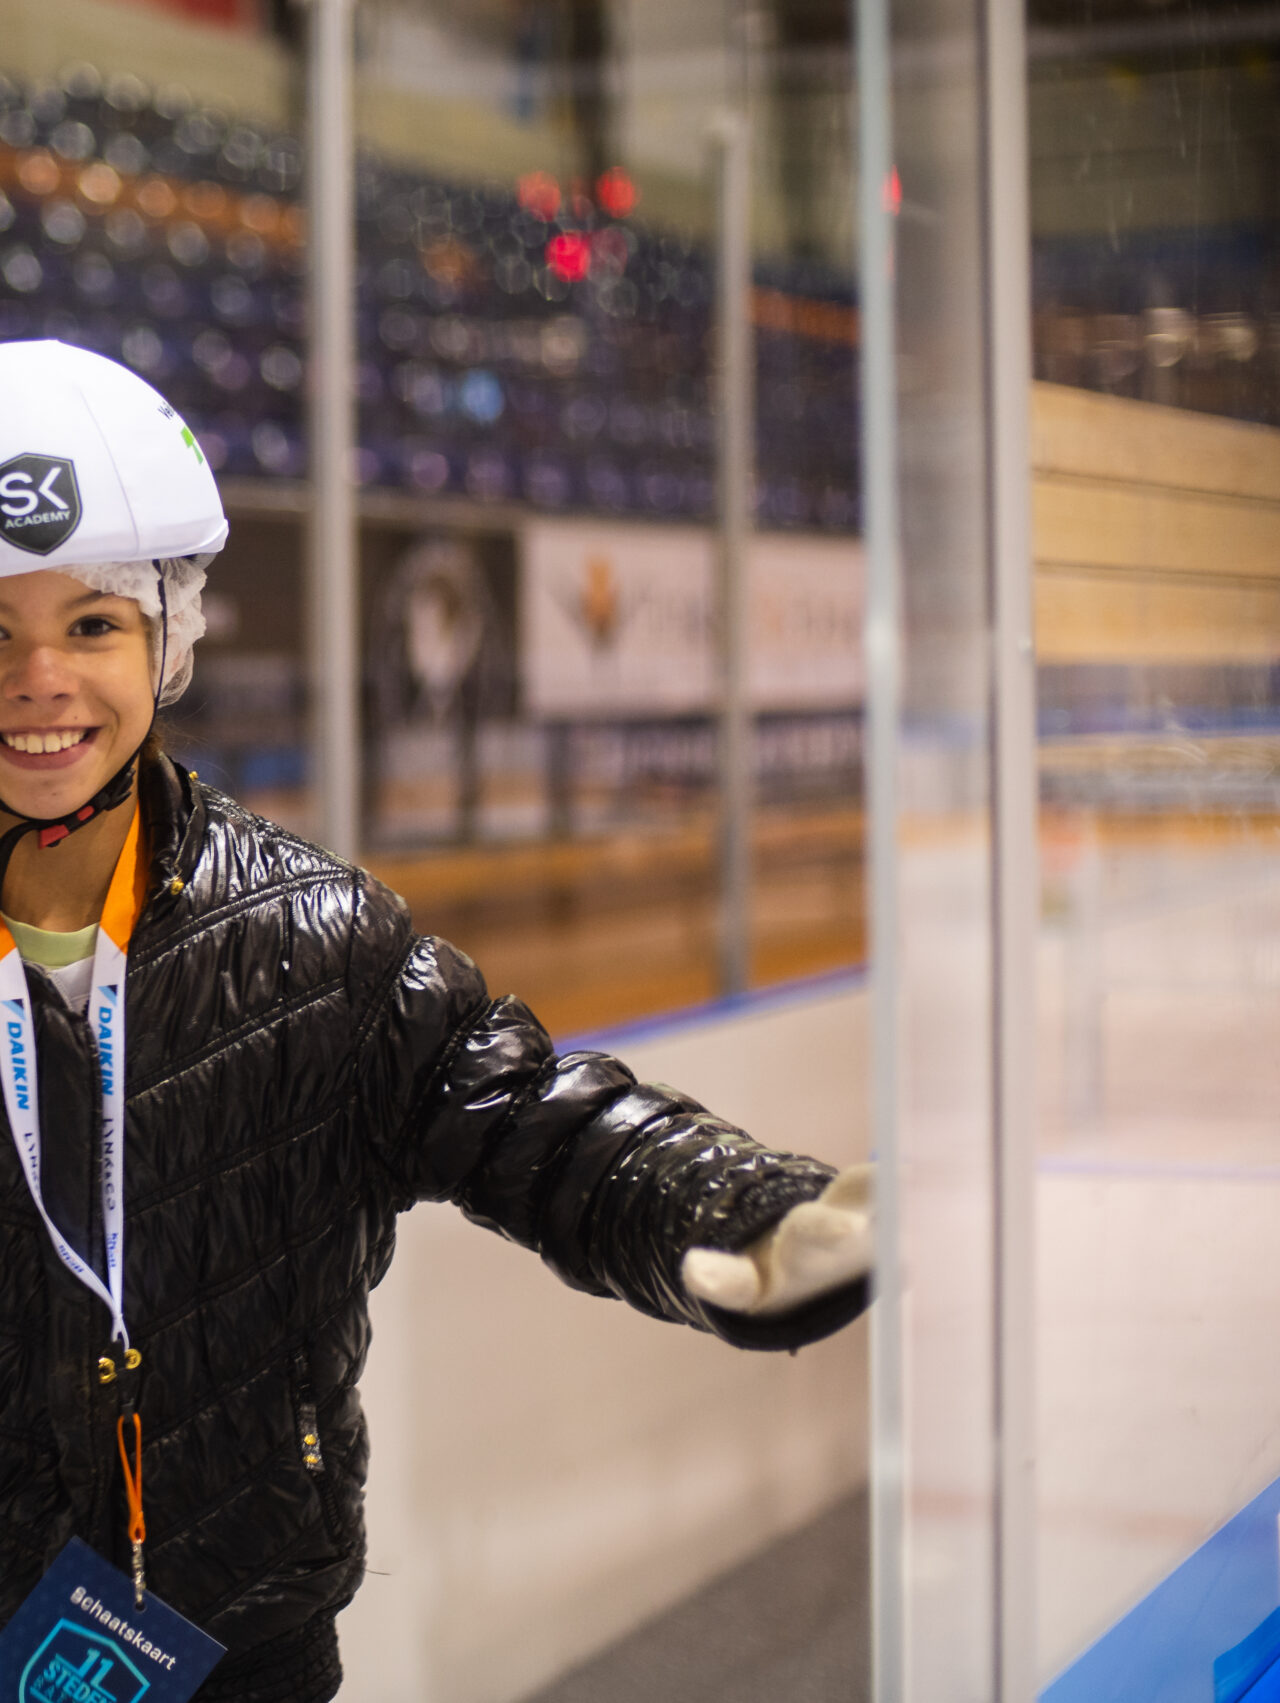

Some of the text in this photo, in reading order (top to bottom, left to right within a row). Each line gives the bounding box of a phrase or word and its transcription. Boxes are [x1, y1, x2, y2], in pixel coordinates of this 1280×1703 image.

[4, 511, 70, 529] ACADEMY
[7, 1021, 29, 1110] DAIKIN
[98, 1006, 114, 1096] DAIKIN
[71, 1586, 176, 1671] Schaatskaart
